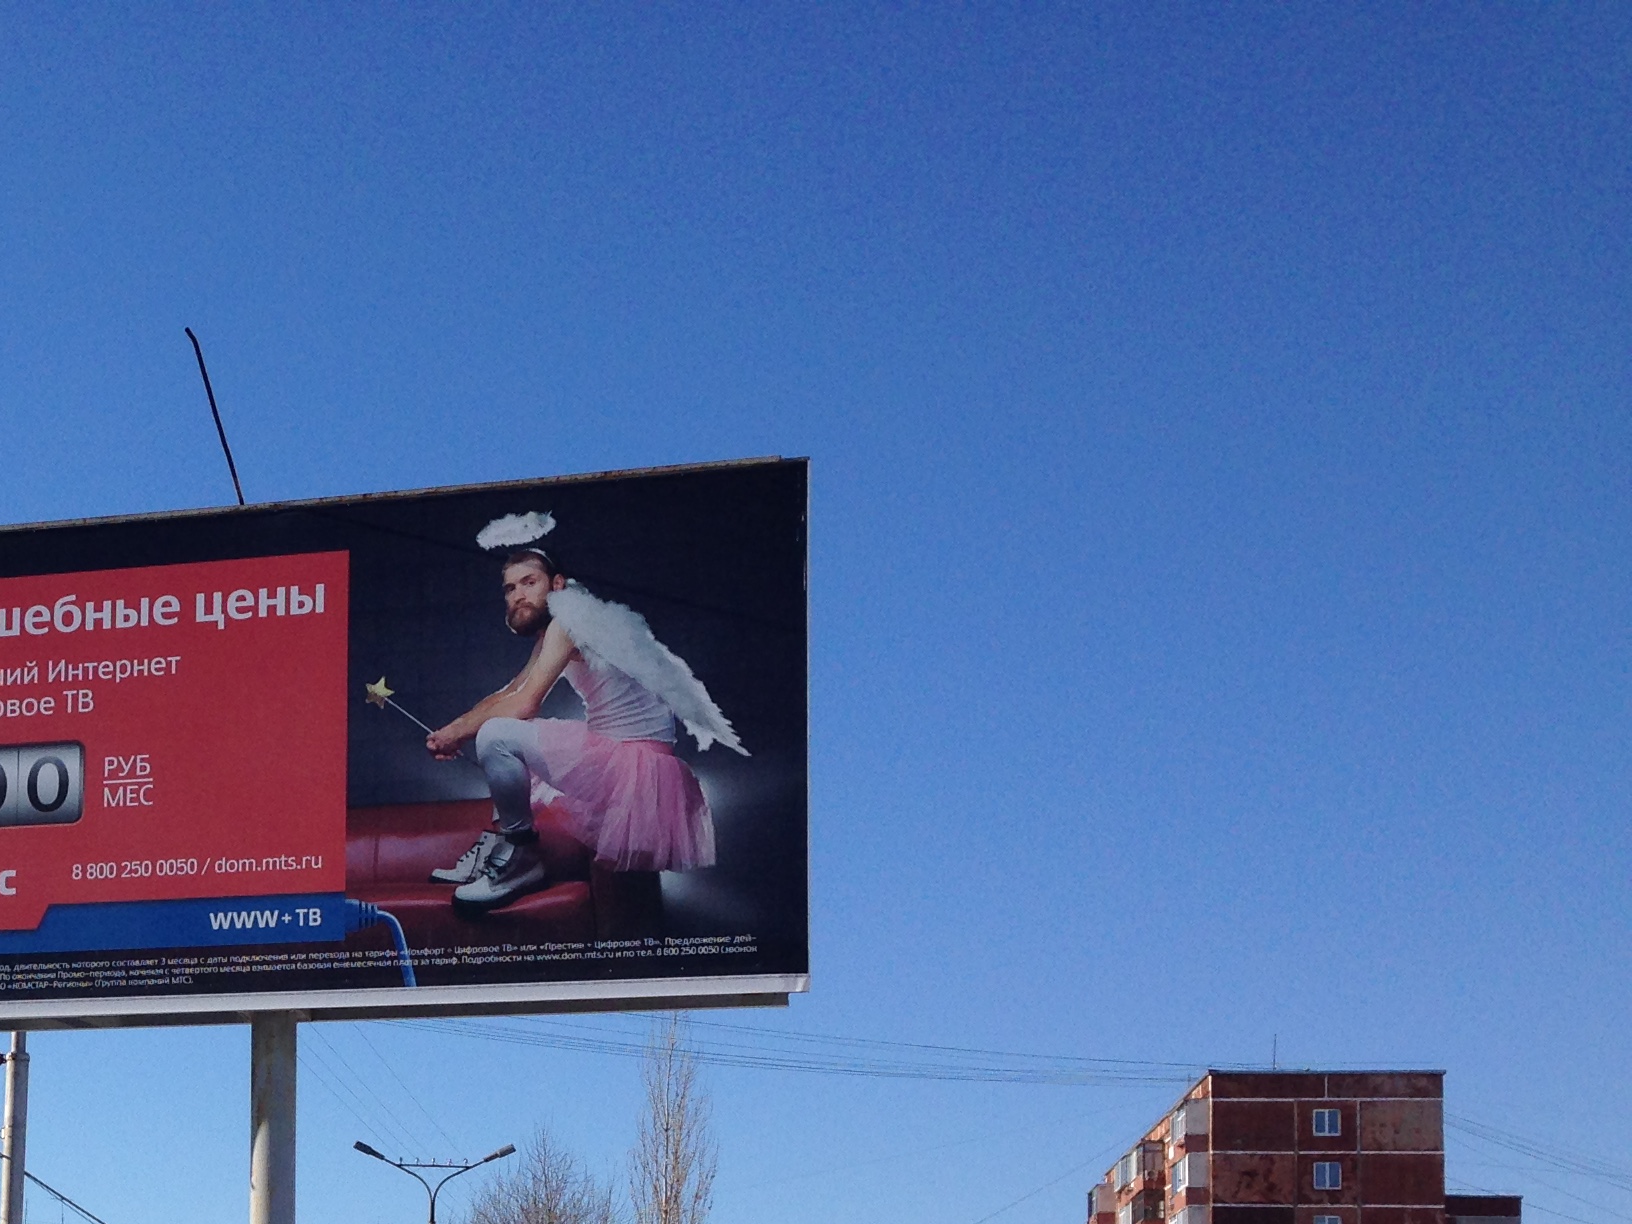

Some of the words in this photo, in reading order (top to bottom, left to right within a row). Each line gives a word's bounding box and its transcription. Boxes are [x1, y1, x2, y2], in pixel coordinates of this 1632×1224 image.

[195, 583, 325, 630] цены
[47, 655, 181, 683] Интернет
[63, 689, 94, 713] ТВ
[104, 754, 151, 777] РУБ
[103, 784, 154, 808] МЕС
[71, 864, 83, 880] 8
[86, 862, 117, 879] 800
[120, 860, 152, 878] 250
[156, 858, 198, 876] 0050
[214, 853, 323, 874] dom.mts.ru
